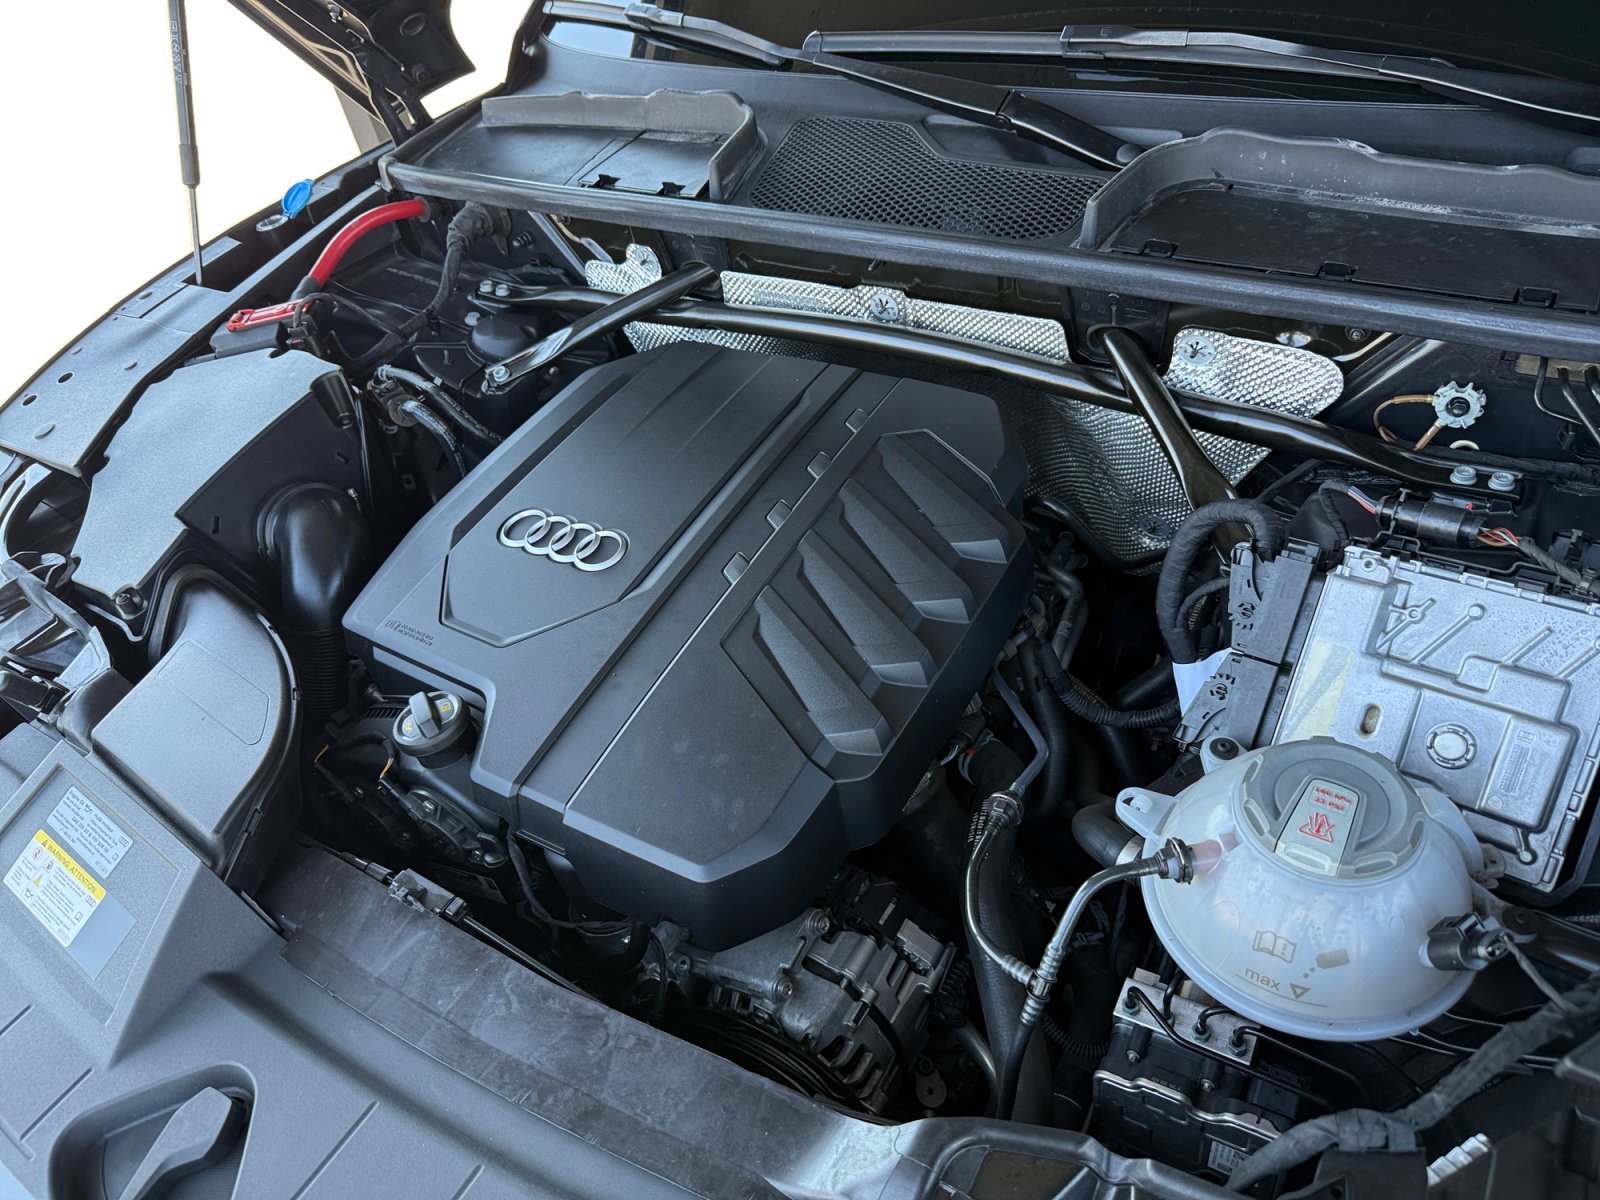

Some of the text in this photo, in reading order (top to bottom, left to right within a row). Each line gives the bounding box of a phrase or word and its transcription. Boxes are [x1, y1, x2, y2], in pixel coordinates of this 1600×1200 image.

[47, 846, 70, 867] WARNING
[70, 866, 97, 893] ATTENTION
[1245, 968, 1280, 990] max
